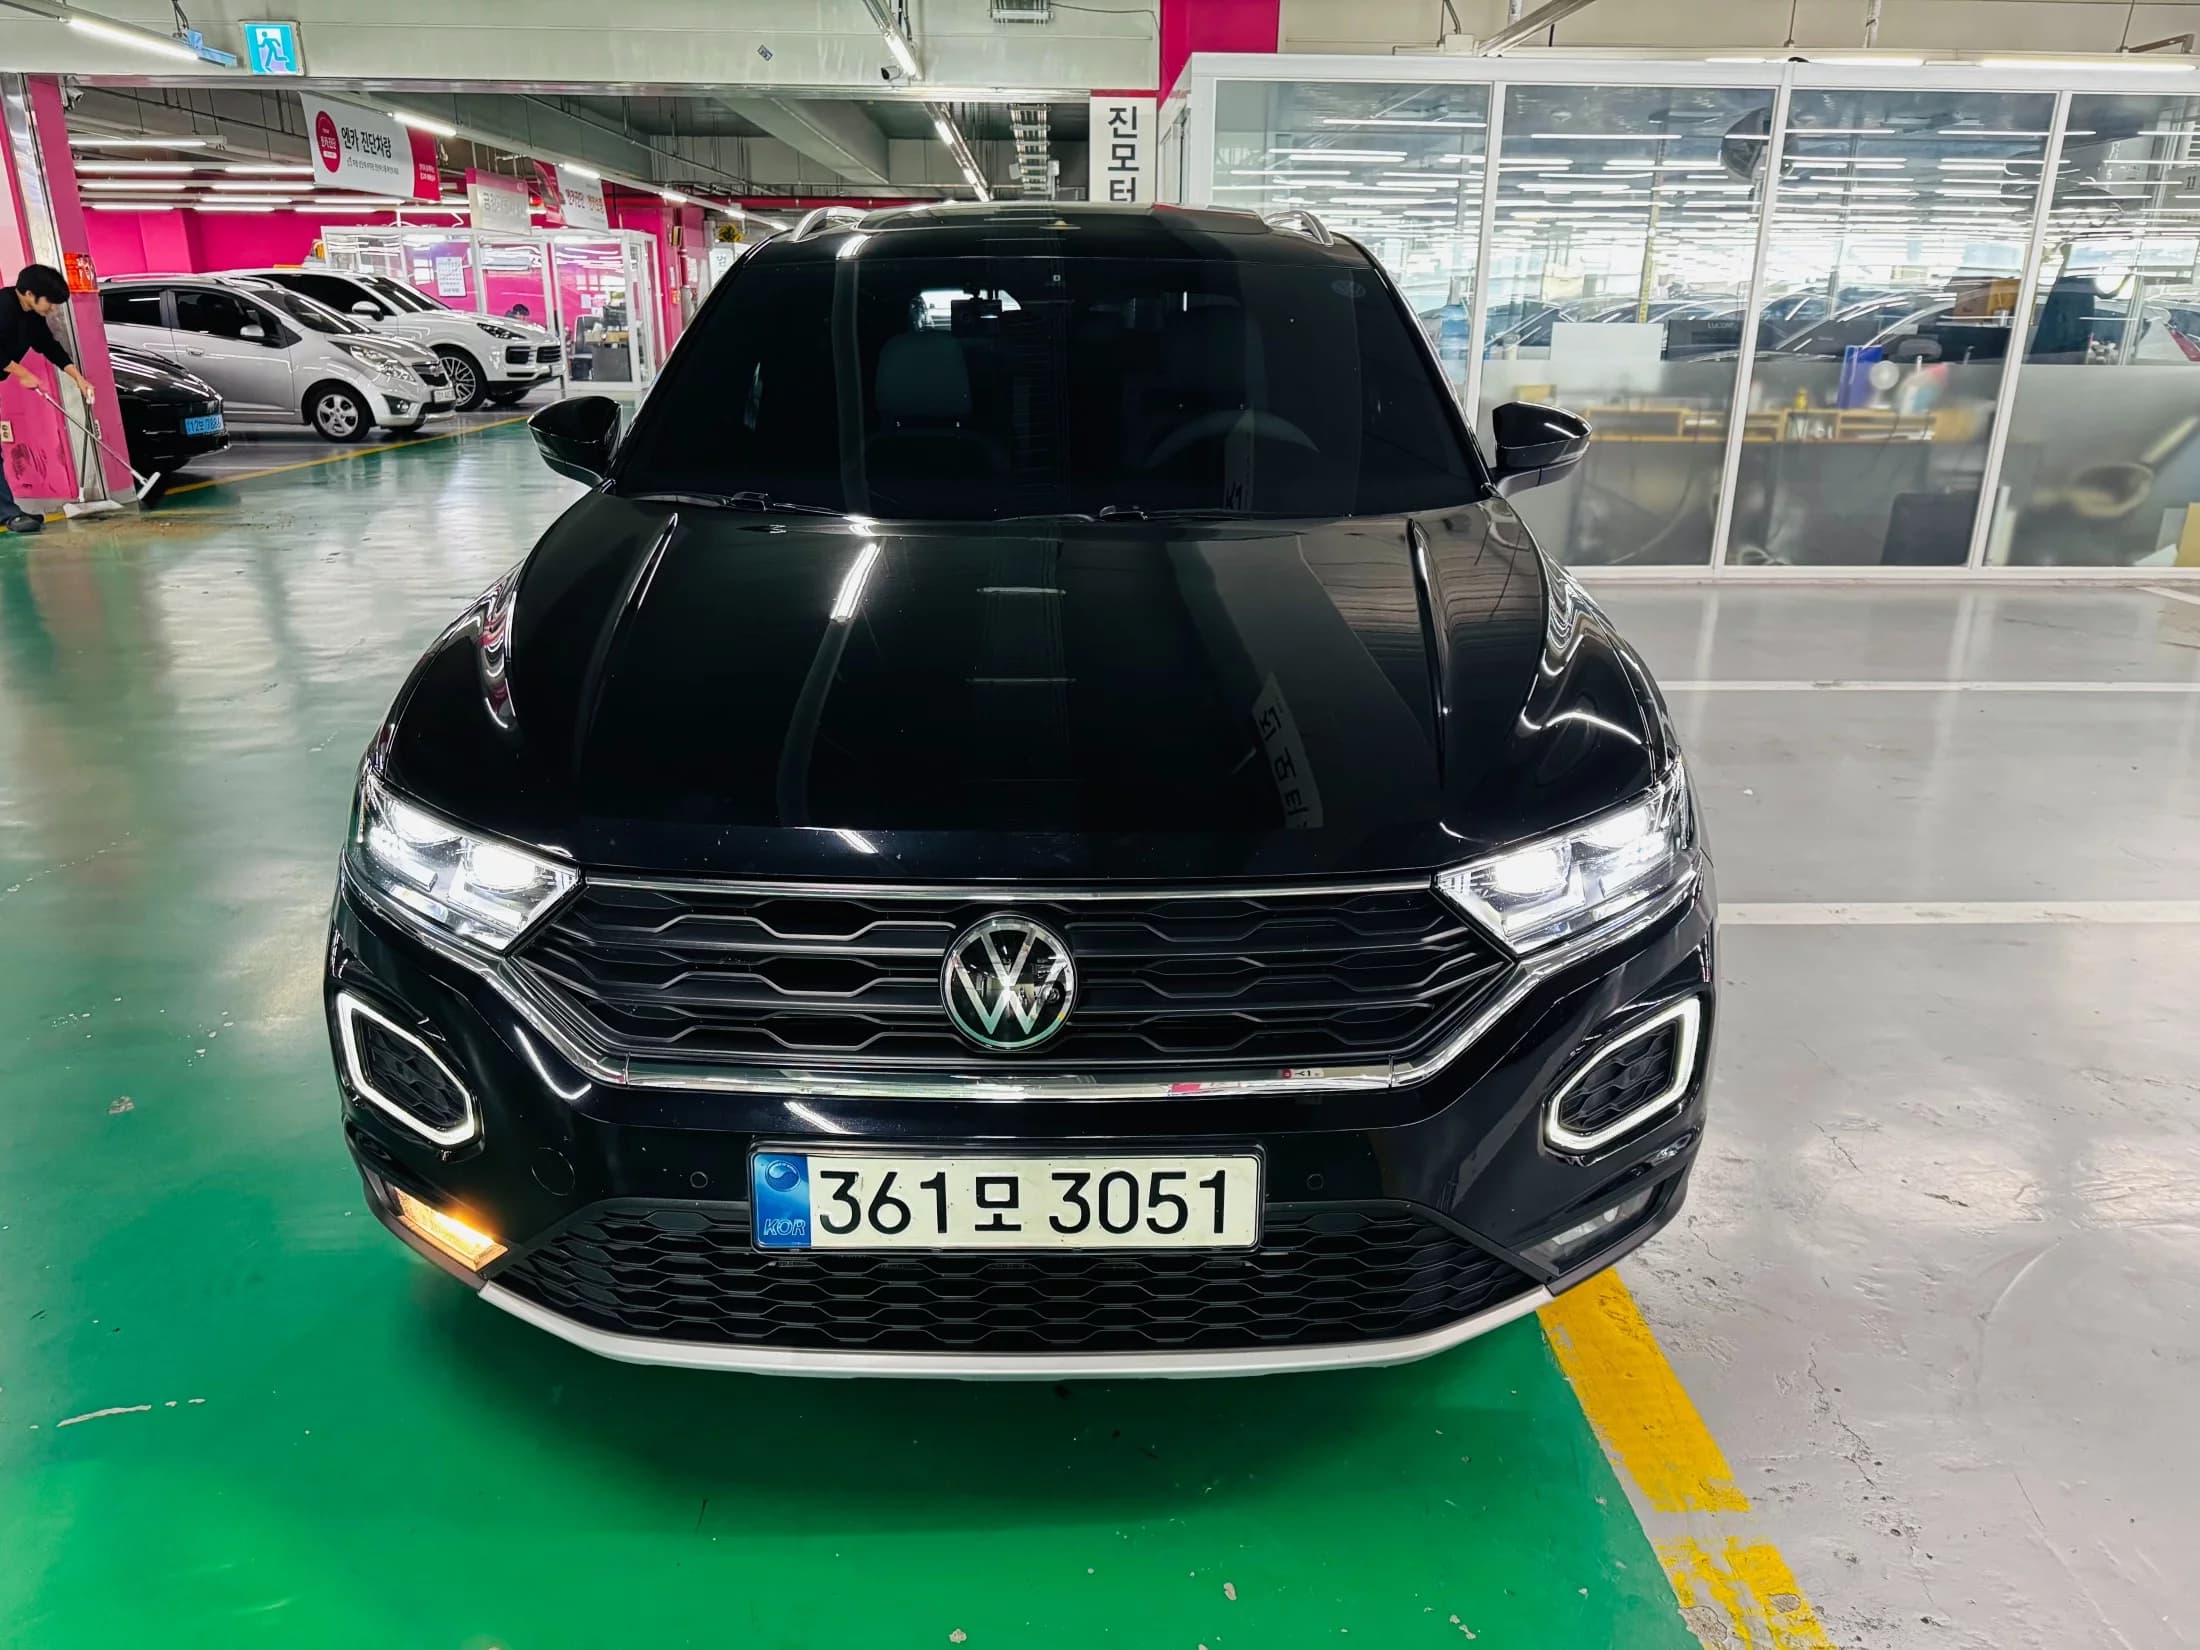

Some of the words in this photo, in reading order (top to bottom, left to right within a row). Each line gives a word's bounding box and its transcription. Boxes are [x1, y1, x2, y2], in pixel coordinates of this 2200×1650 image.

[341, 127, 360, 152] 엔카
[361, 131, 392, 158] 진단차량
[1107, 106, 1140, 202] 진모터
[763, 1218, 806, 1236] KOR
